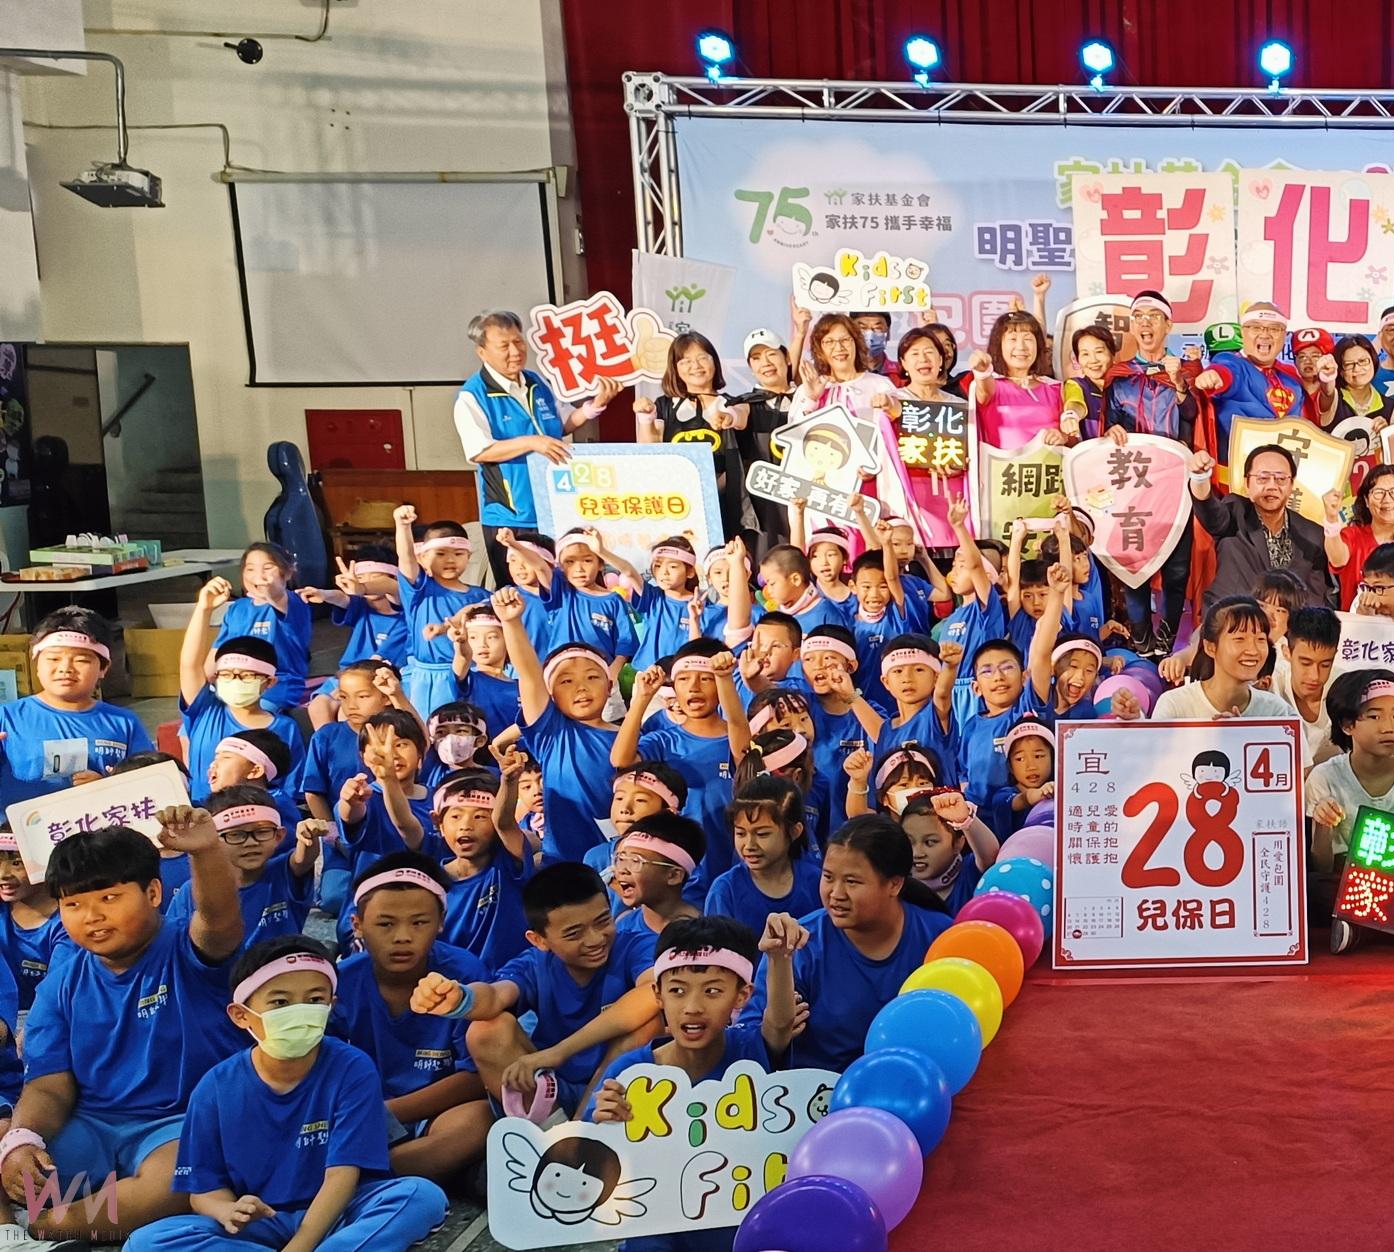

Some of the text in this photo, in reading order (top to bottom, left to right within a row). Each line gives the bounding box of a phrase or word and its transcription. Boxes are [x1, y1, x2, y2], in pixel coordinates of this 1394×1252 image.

[851, 193, 931, 207] 家扶基金會
[734, 186, 813, 244] 75
[825, 214, 952, 231] 家扶75 攜手幸福
[840, 253, 901, 280] Kids
[860, 285, 928, 307] First
[1219, 327, 1229, 338] L
[539, 303, 635, 391] 挺
[902, 406, 963, 434] 彰化
[898, 437, 963, 466] 家扶
[579, 496, 685, 516] 兒童保護日
[1107, 449, 1152, 552] 教育
[1076, 749, 1110, 775] 宜
[1250, 748, 1287, 788] 4月
[1121, 781, 1244, 889] 28
[1137, 898, 1236, 931] 兒保日
[624, 1074, 795, 1147] Kids
